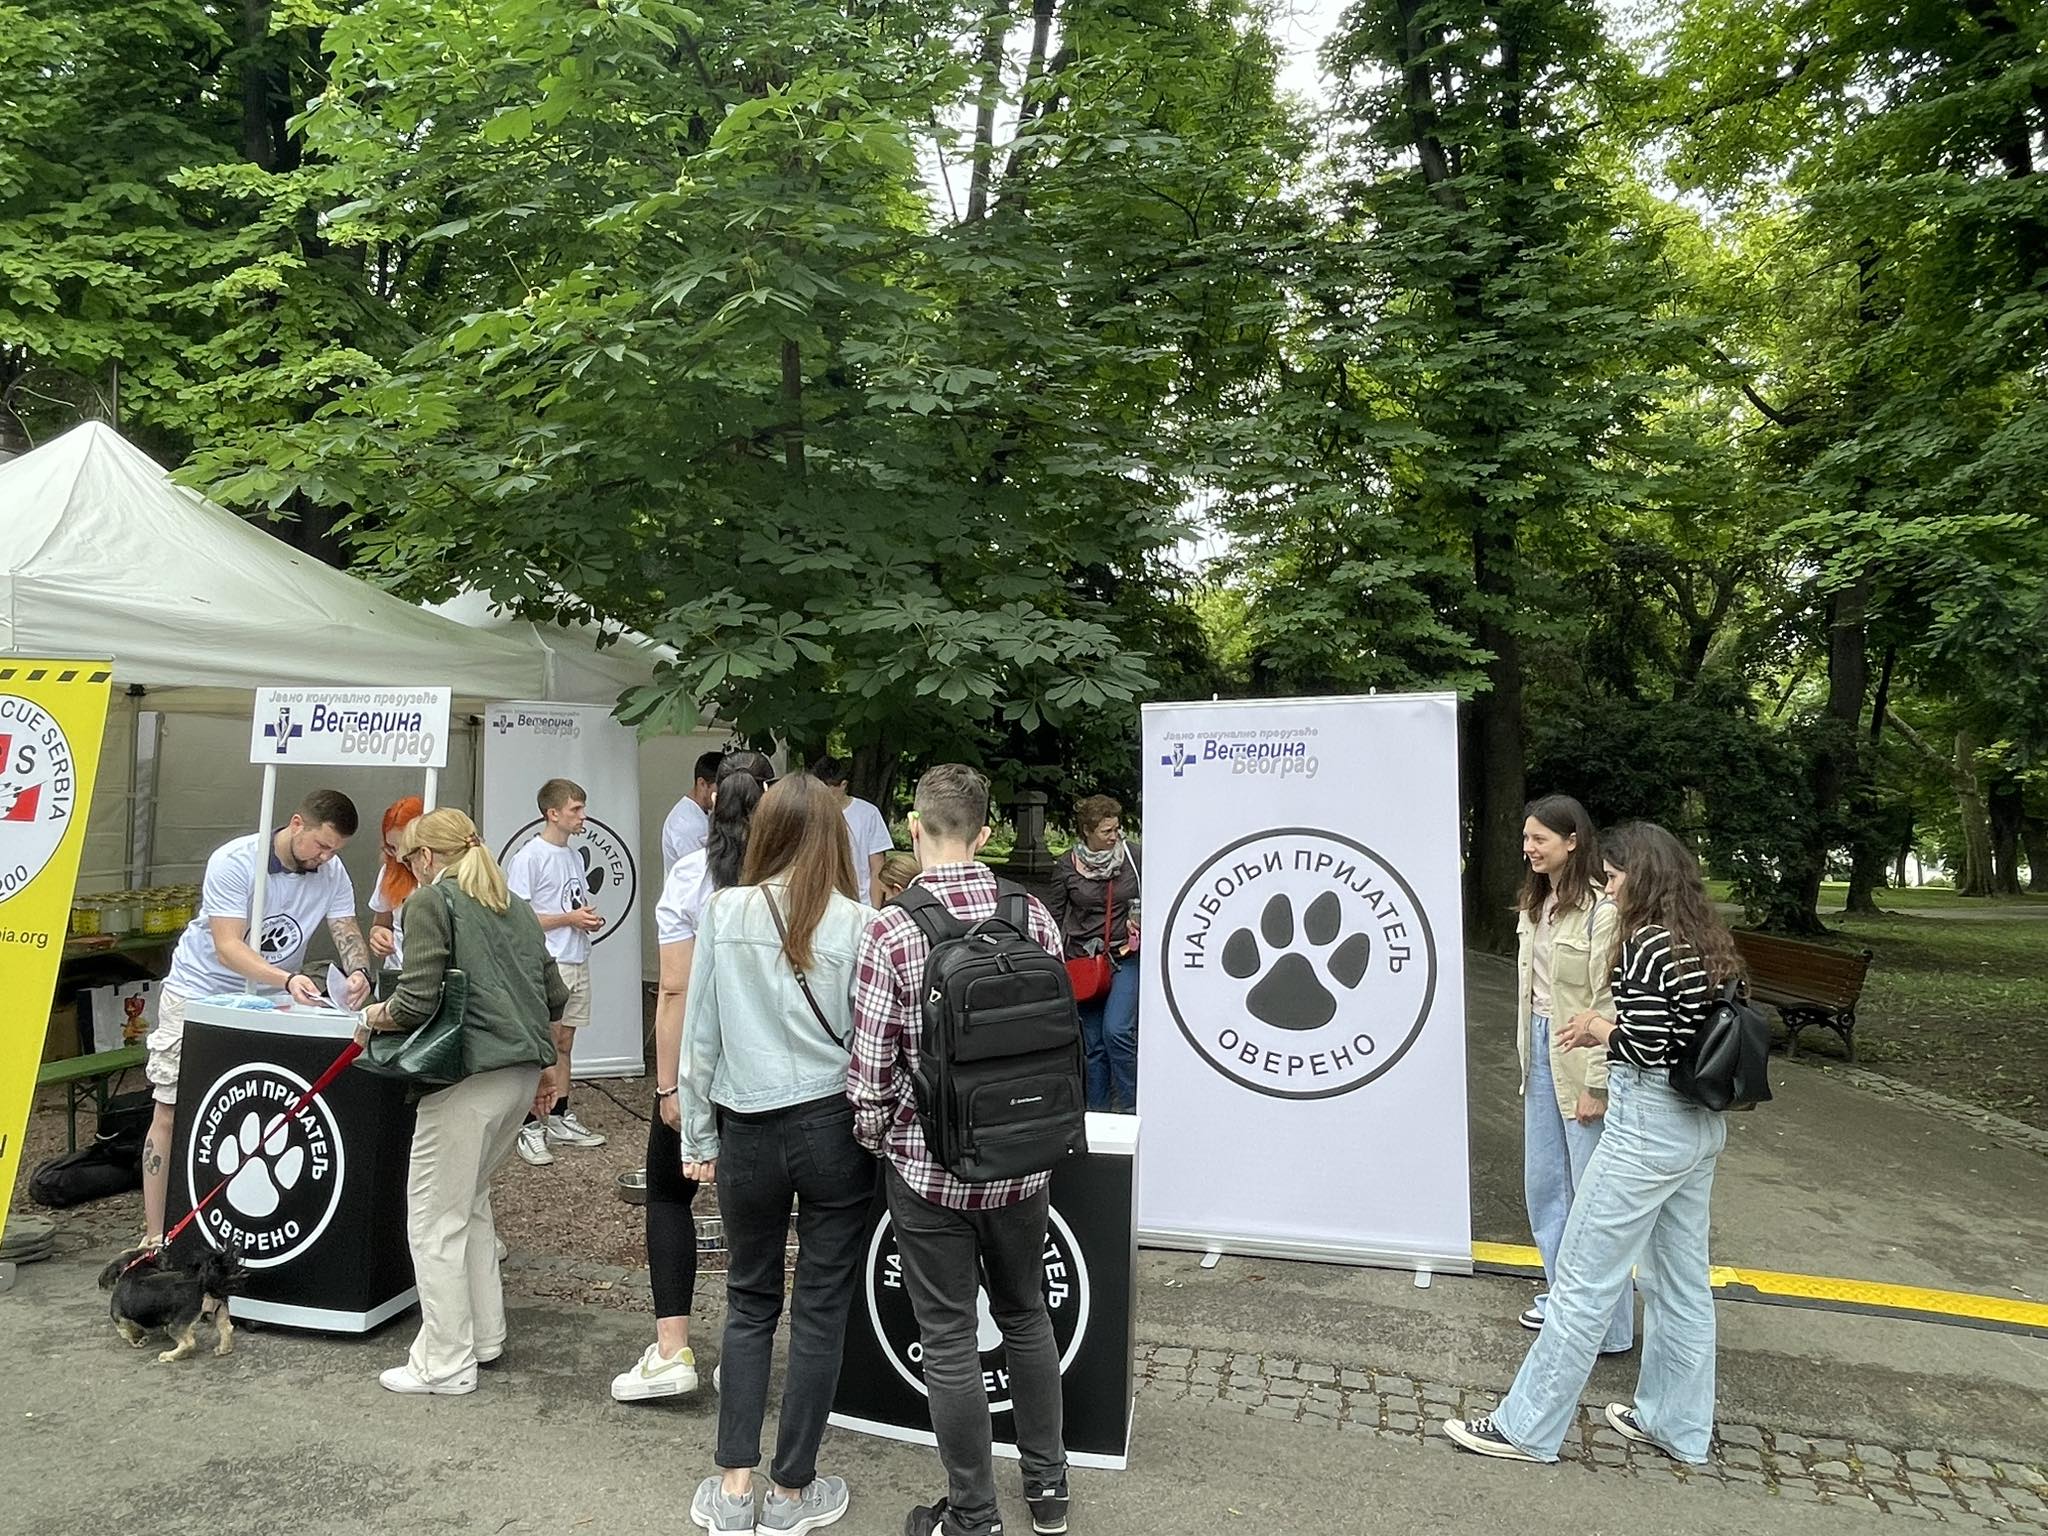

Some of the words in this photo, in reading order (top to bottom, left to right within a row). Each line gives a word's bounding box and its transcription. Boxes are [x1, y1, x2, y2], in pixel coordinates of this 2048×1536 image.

[269, 690, 303, 704] Јавно
[305, 692, 371, 706] комунално
[374, 691, 438, 707] предузеће
[310, 704, 422, 734] Ветерина
[517, 714, 574, 727] Ветерина
[340, 724, 435, 763] Београд
[1203, 740, 1306, 760] Ветерина
[42, 728, 70, 820] SERBIA
[1232, 752, 1319, 779] Београд
[1184, 850, 1284, 969] НАЈБОЉИ
[1294, 850, 1411, 973] ПРИЈАТЕЉ
[0, 926, 48, 949] ia.org
[1218, 1029, 1375, 1076] ОВЕРЕНО
[198, 1079, 258, 1164] НАЈБОЉИ
